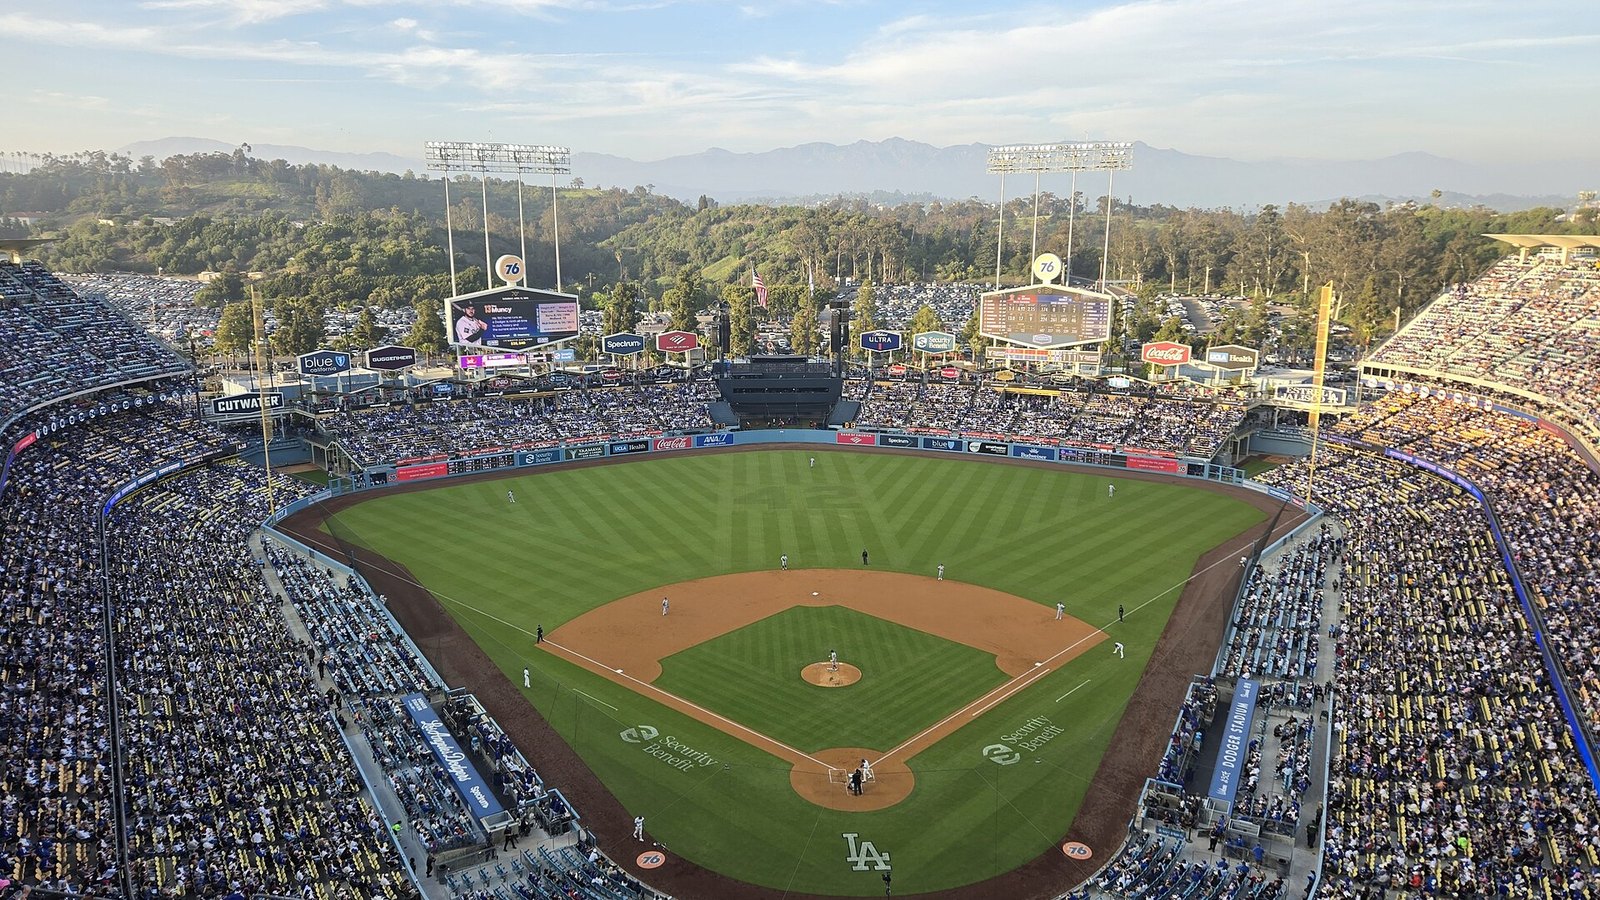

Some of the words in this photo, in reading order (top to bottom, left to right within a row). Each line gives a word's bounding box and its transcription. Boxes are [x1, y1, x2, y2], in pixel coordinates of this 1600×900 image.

[506, 263, 520, 274] 76
[1040, 262, 1054, 272] 76
[484, 305, 492, 313] 13
[607, 340, 639, 348] Spectrum
[305, 358, 333, 367] blue
[218, 395, 280, 412] CUTWATER
[1231, 702, 1248, 733] STADIUM
[1001, 715, 1052, 744] Security
[1018, 725, 1064, 752] Benefit
[642, 743, 694, 772] Benefit
[659, 735, 718, 767] Security
[1222, 735, 1241, 768] DODGER
[445, 752, 471, 781] Dodgers
[470, 786, 489, 808] Spectrum
[642, 854, 660, 864] 76
[842, 833, 892, 870] LA
[1069, 846, 1087, 855] 76
